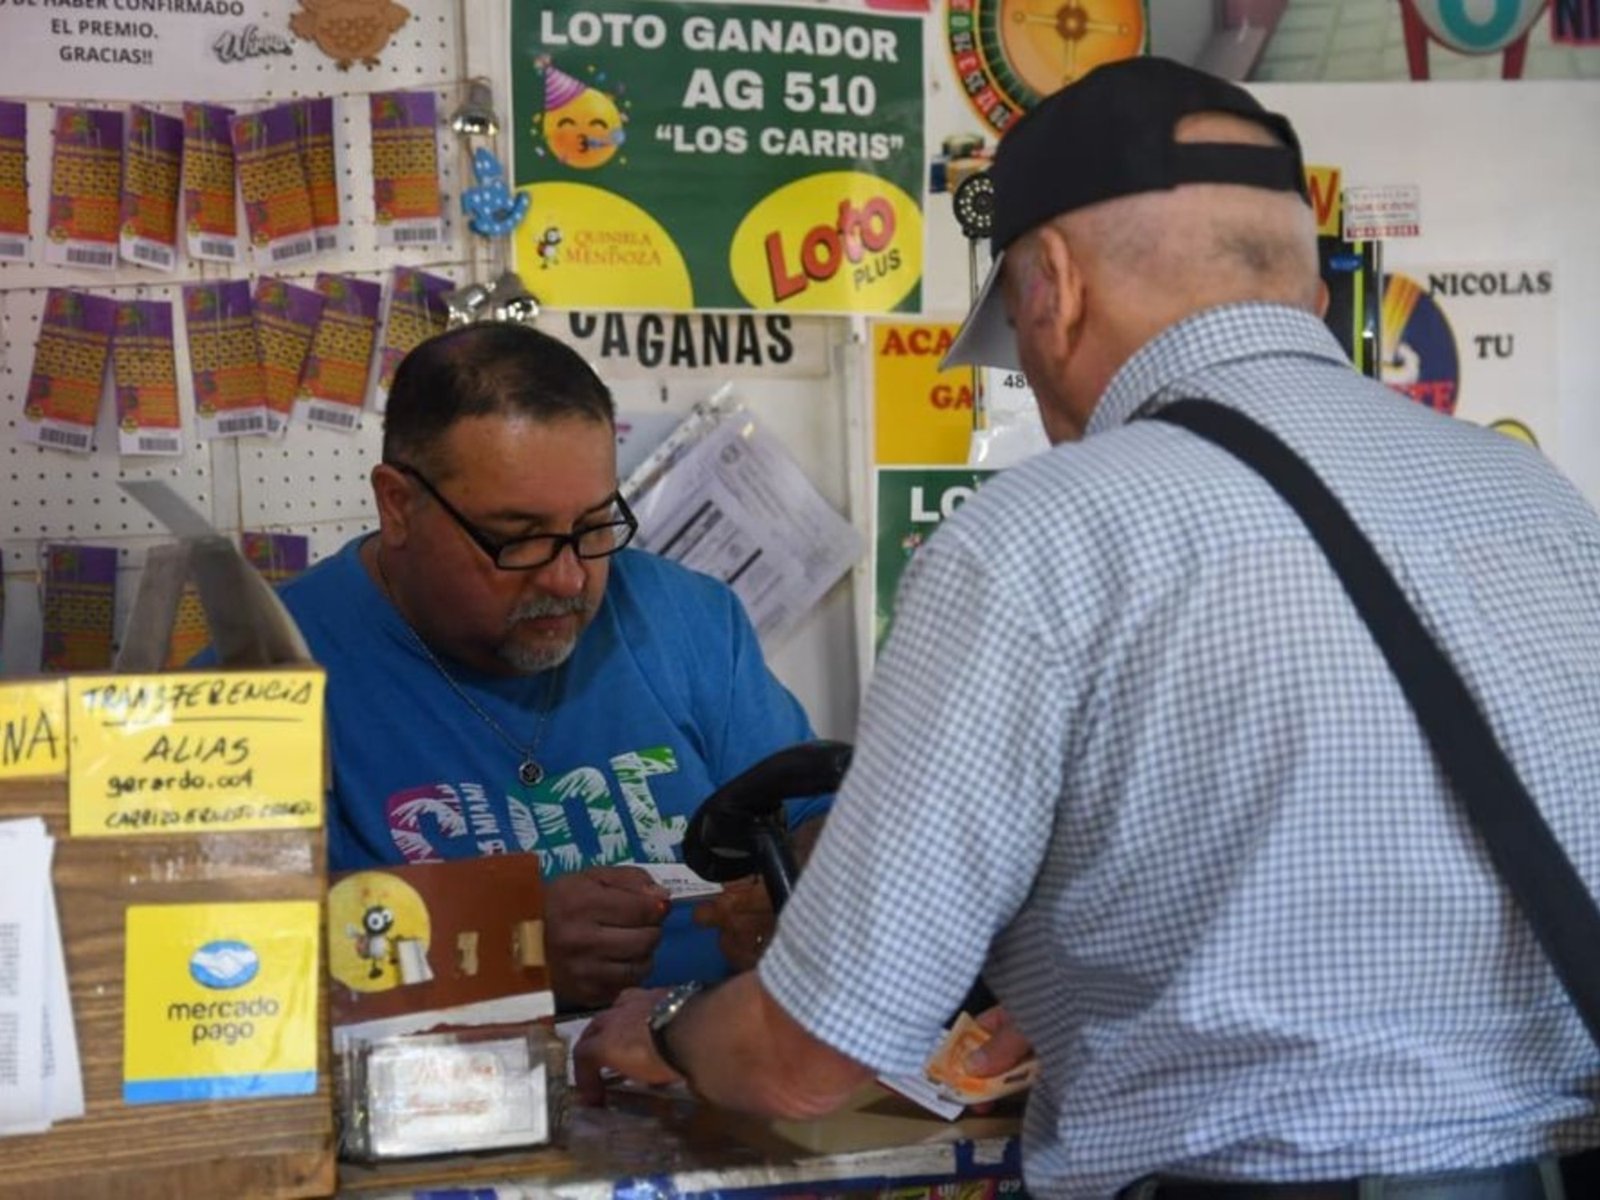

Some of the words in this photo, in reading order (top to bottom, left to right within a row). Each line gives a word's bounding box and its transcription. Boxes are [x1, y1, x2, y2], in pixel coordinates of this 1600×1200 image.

[51, 18, 72, 34] EL
[79, 20, 159, 39] PREMIO.
[540, 11, 666, 49] LOTO
[682, 17, 898, 62] GANADOR
[59, 45, 153, 65] GRACIAS!!
[682, 68, 765, 110] AG
[784, 71, 877, 116] 510
[765, 196, 896, 303] Loto
[853, 248, 902, 291] PLUS
[1428, 272, 1552, 296] NICOLAS
[1474, 335, 1514, 358] TU
[143, 734, 250, 764] ALIAS
[167, 997, 279, 1021] mercado
[192, 1022, 254, 1046] pago
